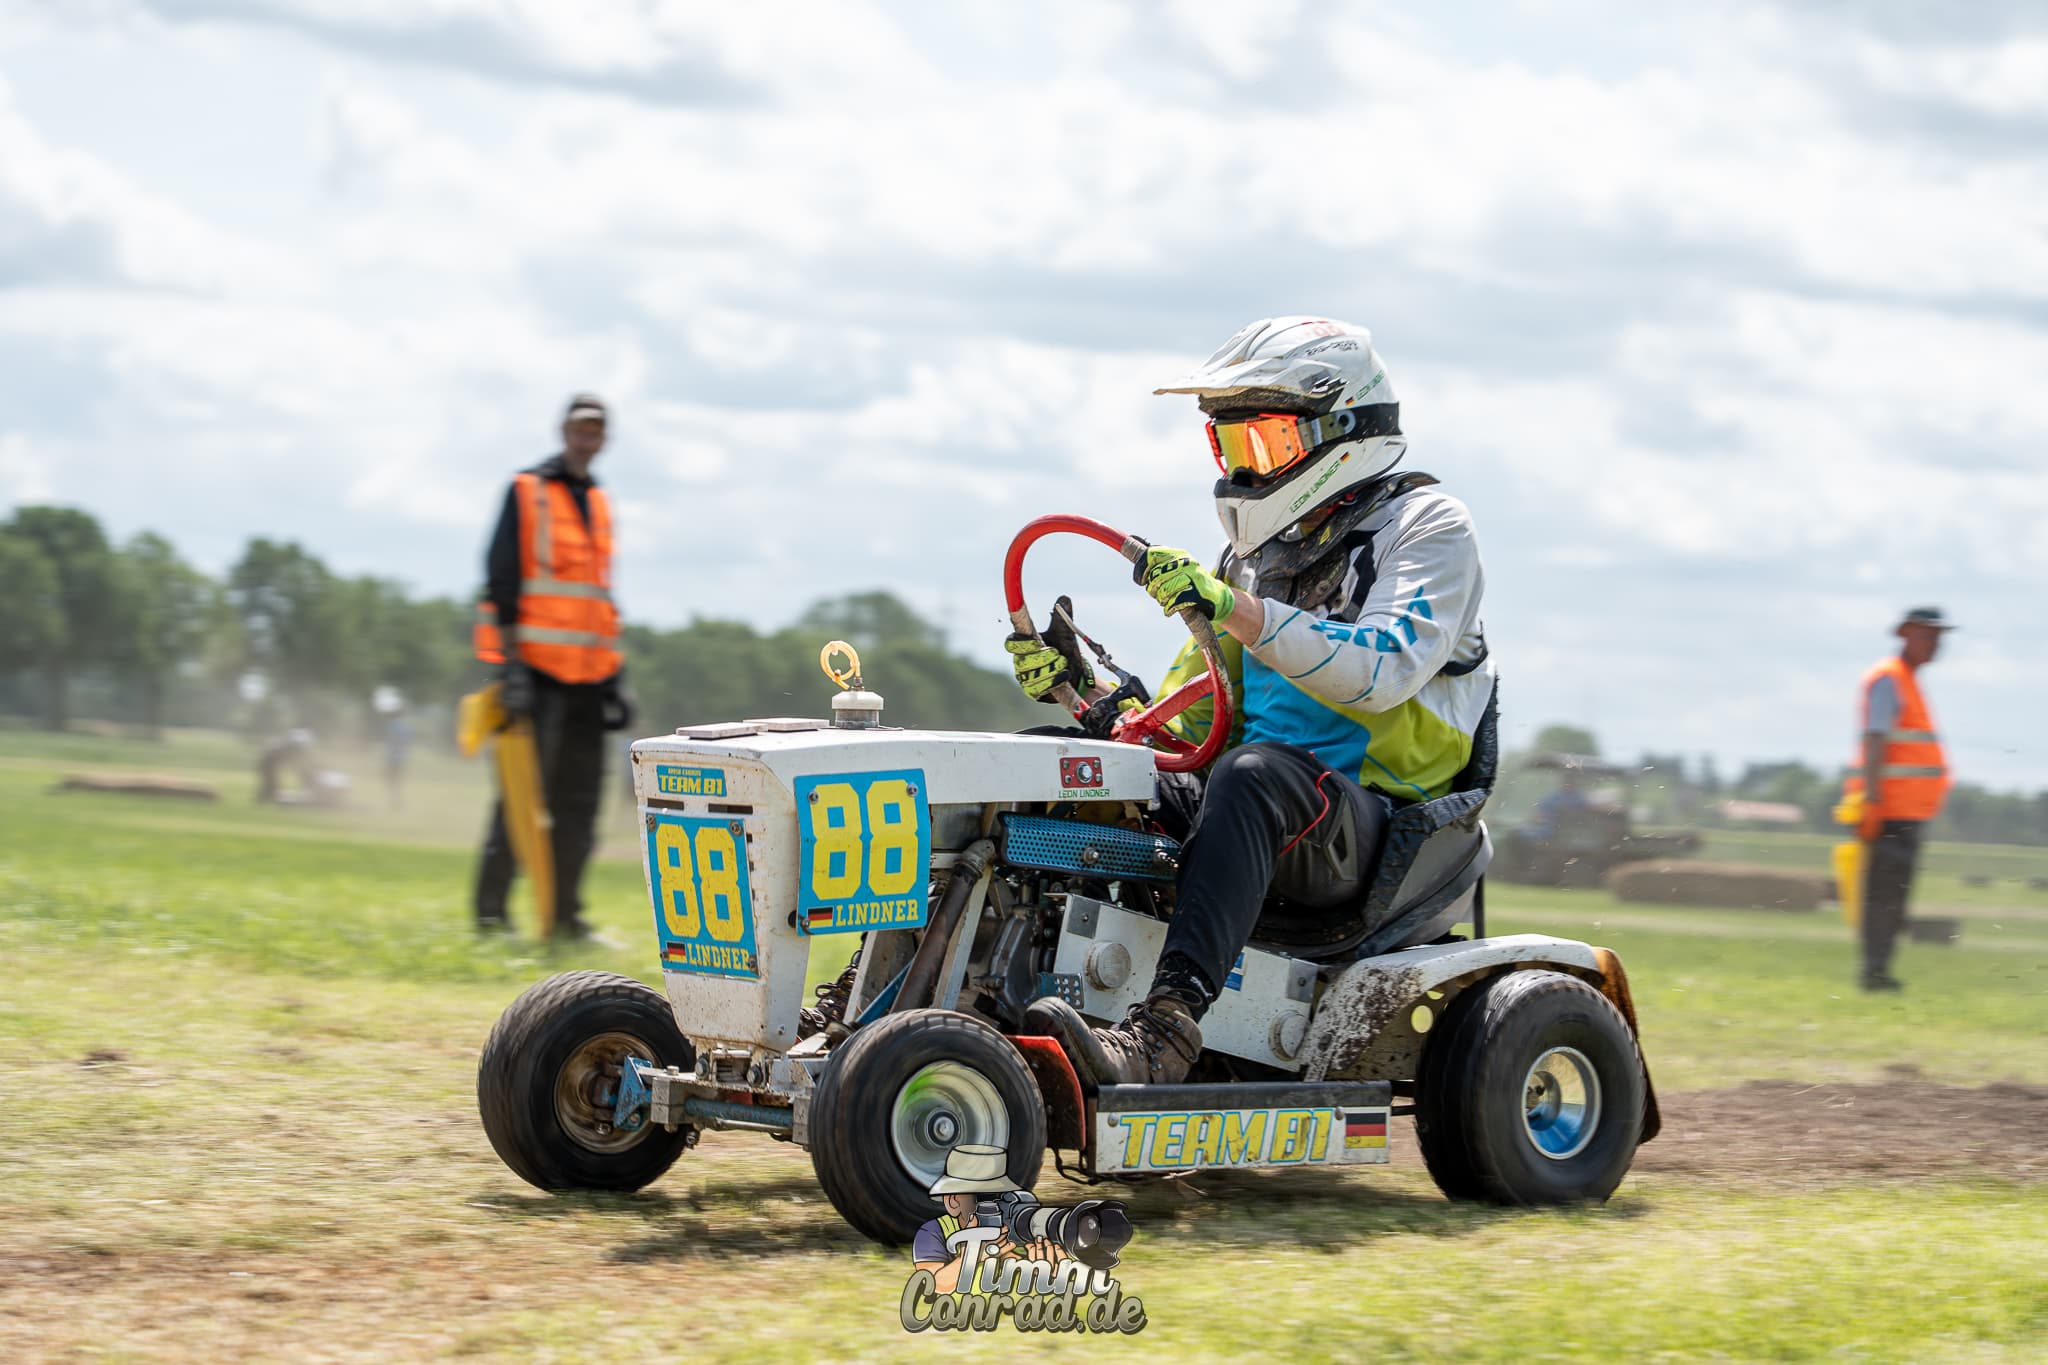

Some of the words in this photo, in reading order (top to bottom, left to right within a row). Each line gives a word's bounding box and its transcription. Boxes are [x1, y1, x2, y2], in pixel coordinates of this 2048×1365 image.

[1290, 491, 1311, 513] LEON
[1311, 460, 1340, 494] LINDNER
[659, 774, 702, 794] TEAM
[1058, 789, 1078, 799] LEON
[1079, 788, 1111, 798] LINDNER
[809, 778, 919, 901] 88
[655, 822, 745, 943] 88
[835, 898, 919, 927] LINDNER
[1119, 1110, 1270, 1169] TEAM
